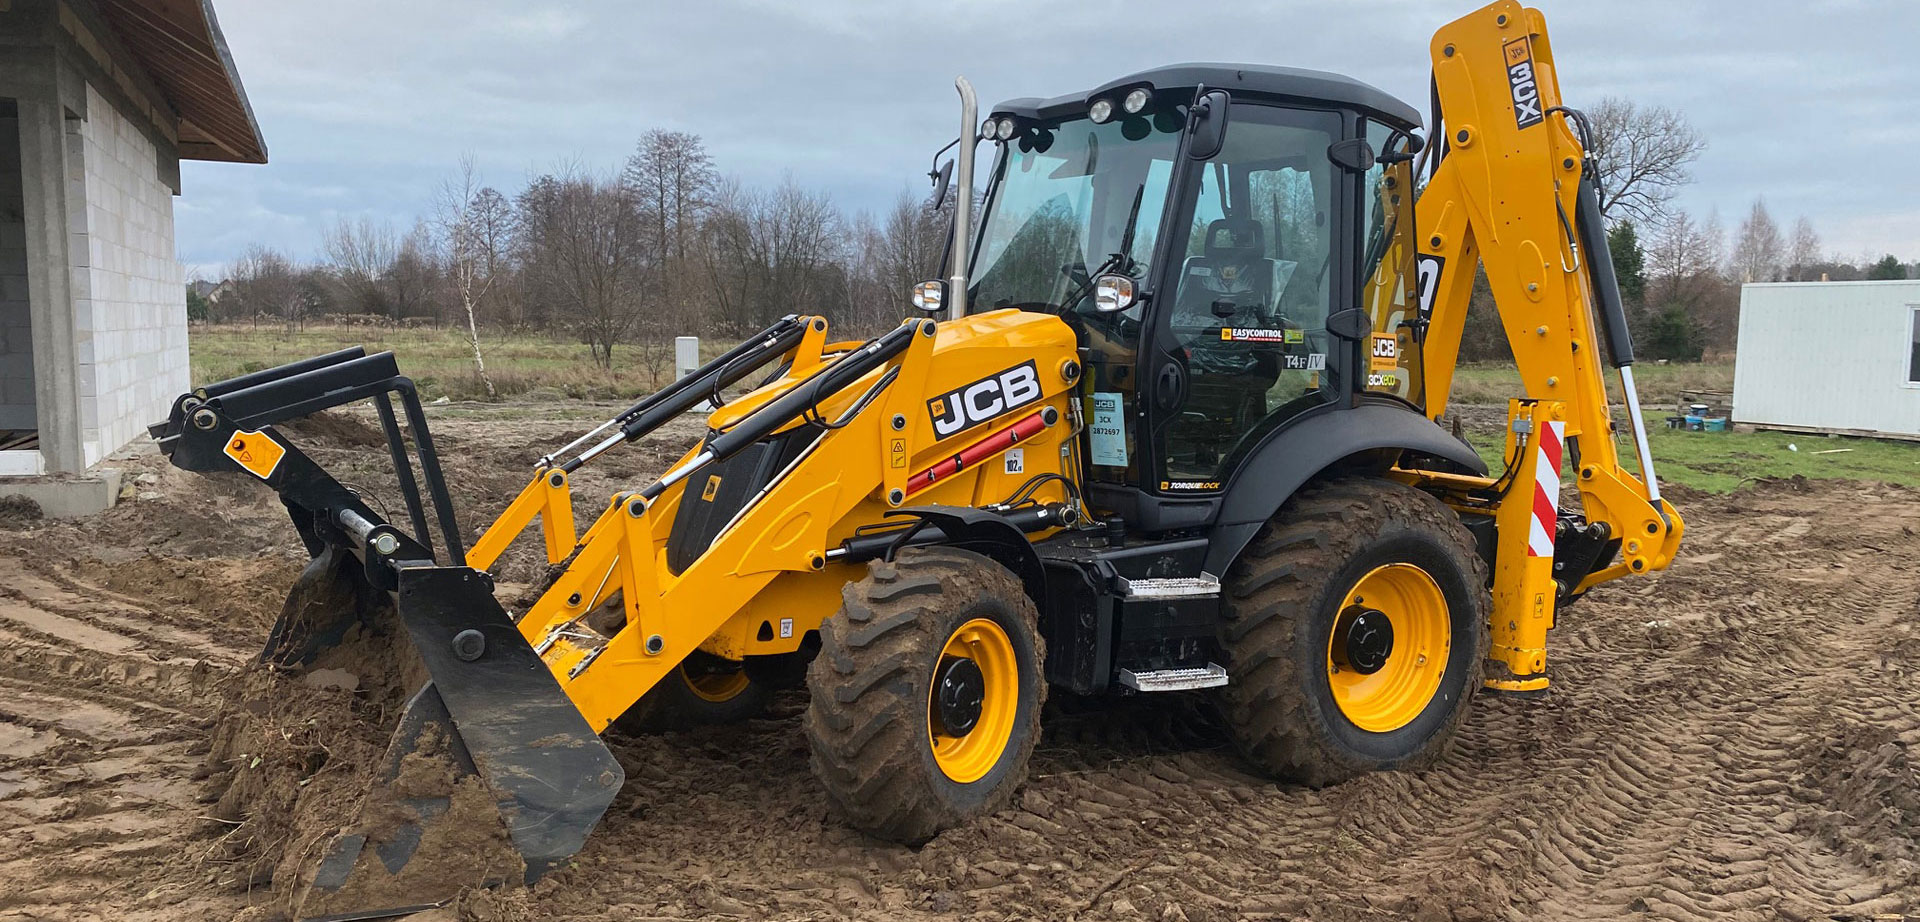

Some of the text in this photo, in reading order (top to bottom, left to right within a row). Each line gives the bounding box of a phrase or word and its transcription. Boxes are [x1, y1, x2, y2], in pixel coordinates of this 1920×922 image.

[1510, 62, 1541, 122] 3CX
[1232, 328, 1283, 340] EASYCONTROL
[1373, 339, 1395, 357] JCB
[935, 365, 1040, 435] JCB
[1095, 400, 1114, 408] JCB
[1099, 416, 1112, 424] 3CX
[1092, 427, 1120, 436] 2872697
